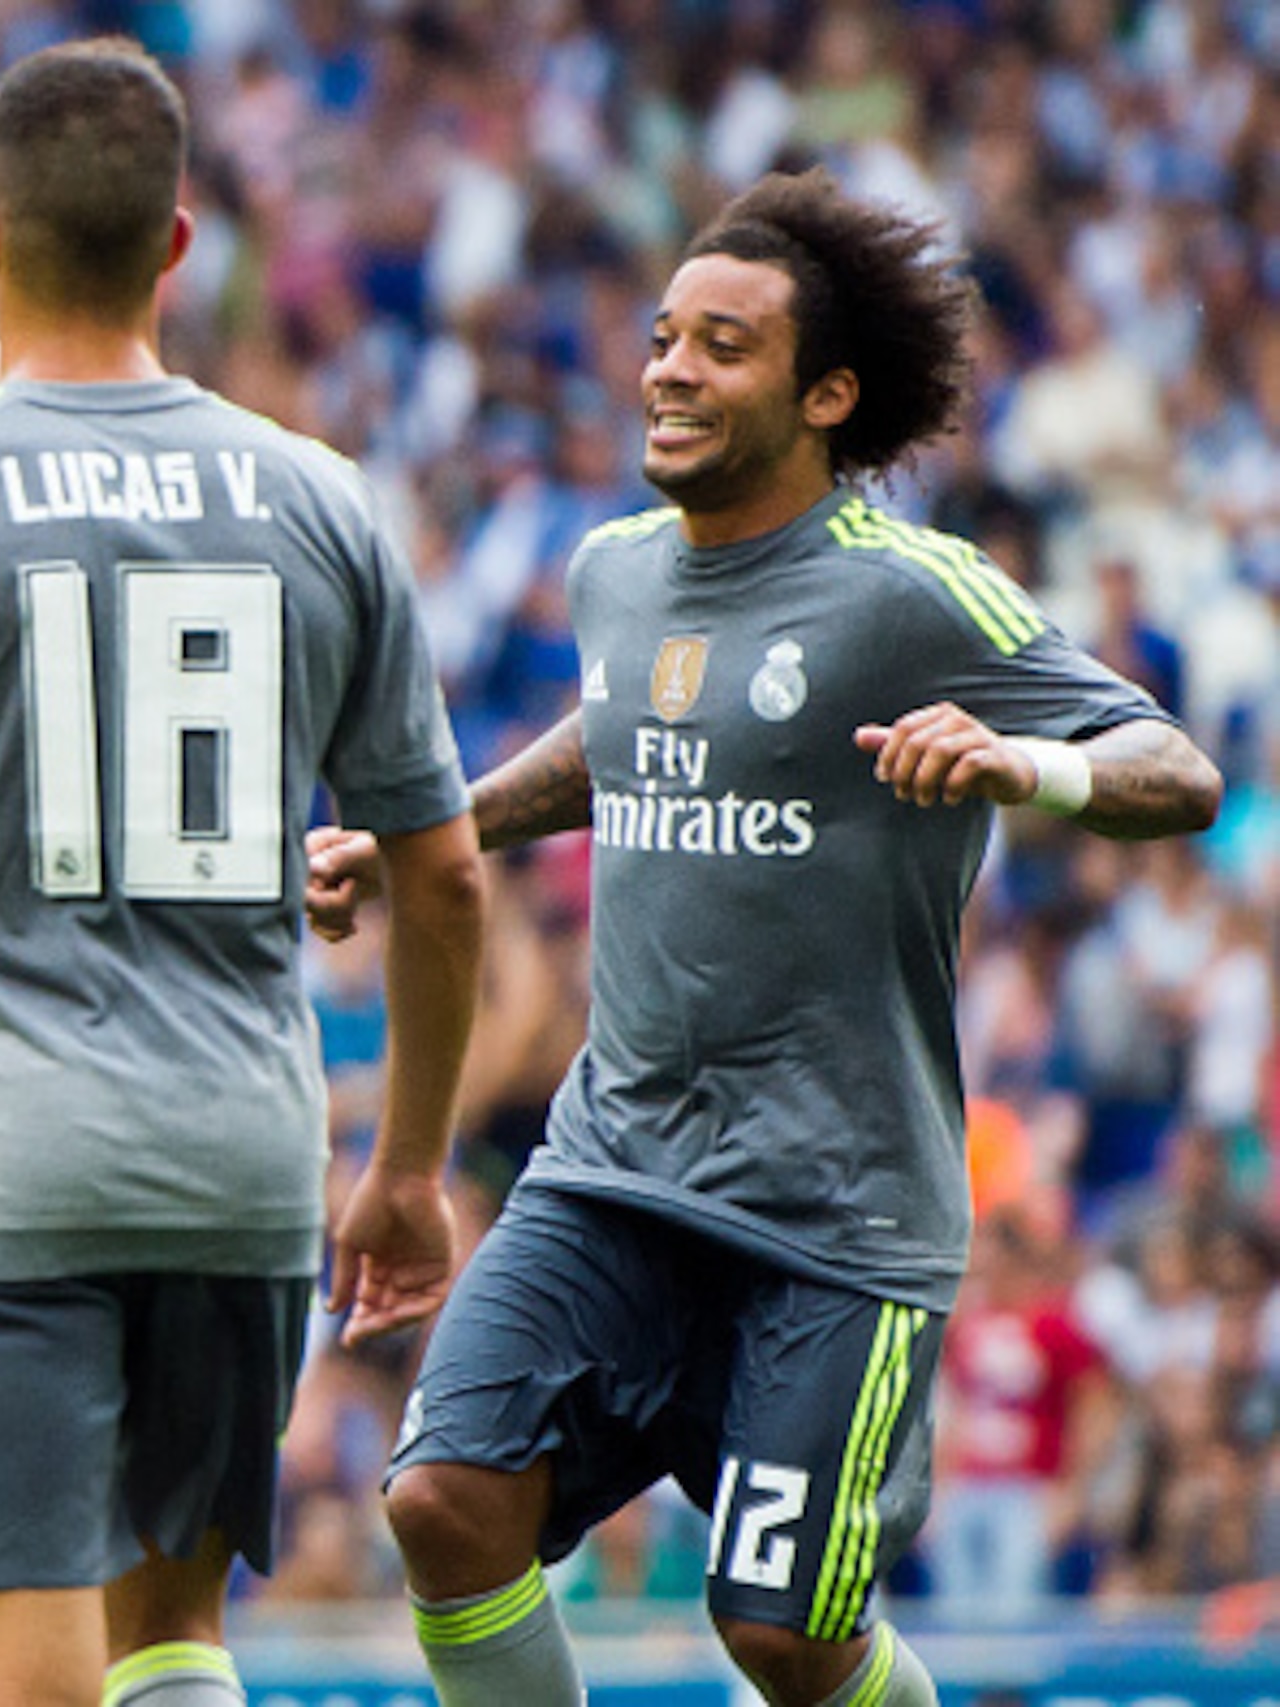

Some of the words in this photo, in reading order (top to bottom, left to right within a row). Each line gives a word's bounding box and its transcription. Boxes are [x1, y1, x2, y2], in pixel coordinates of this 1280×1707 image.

[0, 450, 204, 523] LUCAS
[216, 450, 272, 521] V.
[17, 560, 283, 899] 18
[635, 727, 709, 787] Fly
[592, 779, 816, 856] mirates
[706, 1456, 811, 1591] 12
